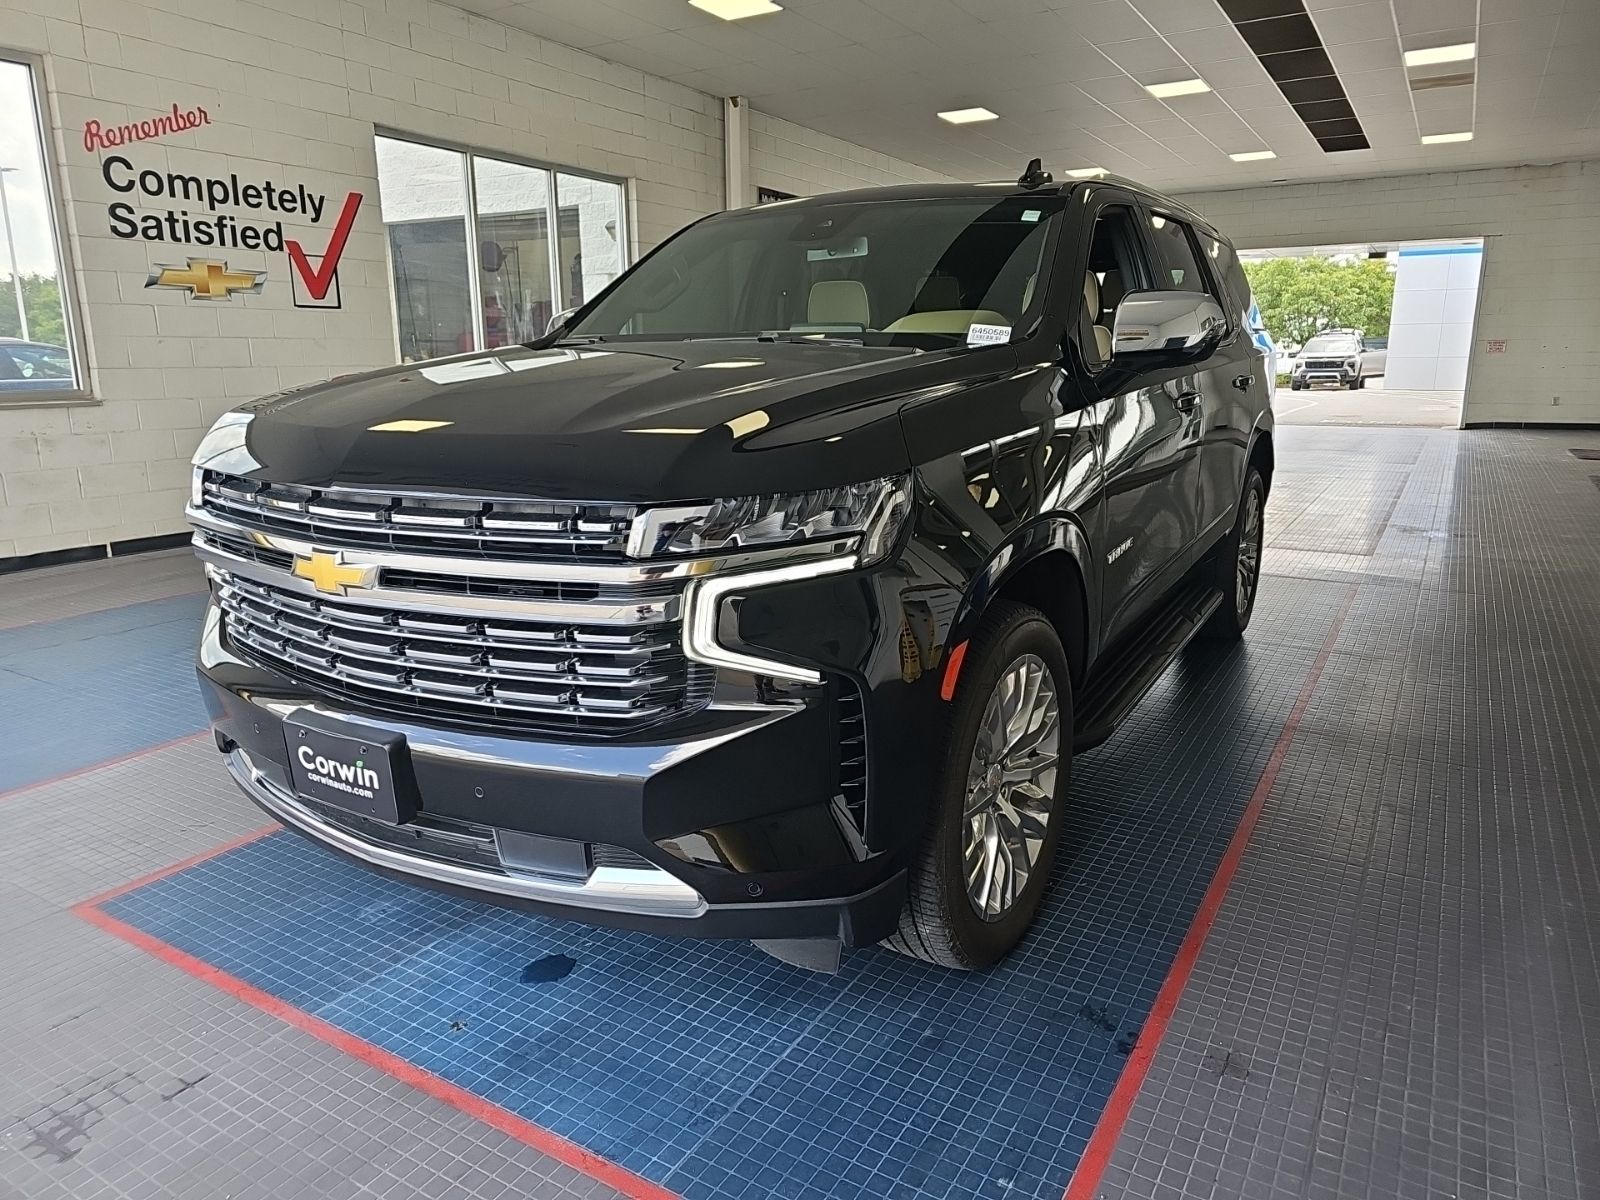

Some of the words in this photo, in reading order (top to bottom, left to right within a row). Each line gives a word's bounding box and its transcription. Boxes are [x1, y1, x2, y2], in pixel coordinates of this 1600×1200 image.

[84, 103, 212, 152] Remember
[102, 155, 325, 223] Completely
[108, 202, 284, 252] Satisfied
[298, 745, 380, 790] Corwin
[307, 772, 374, 799] corwinauto.com
